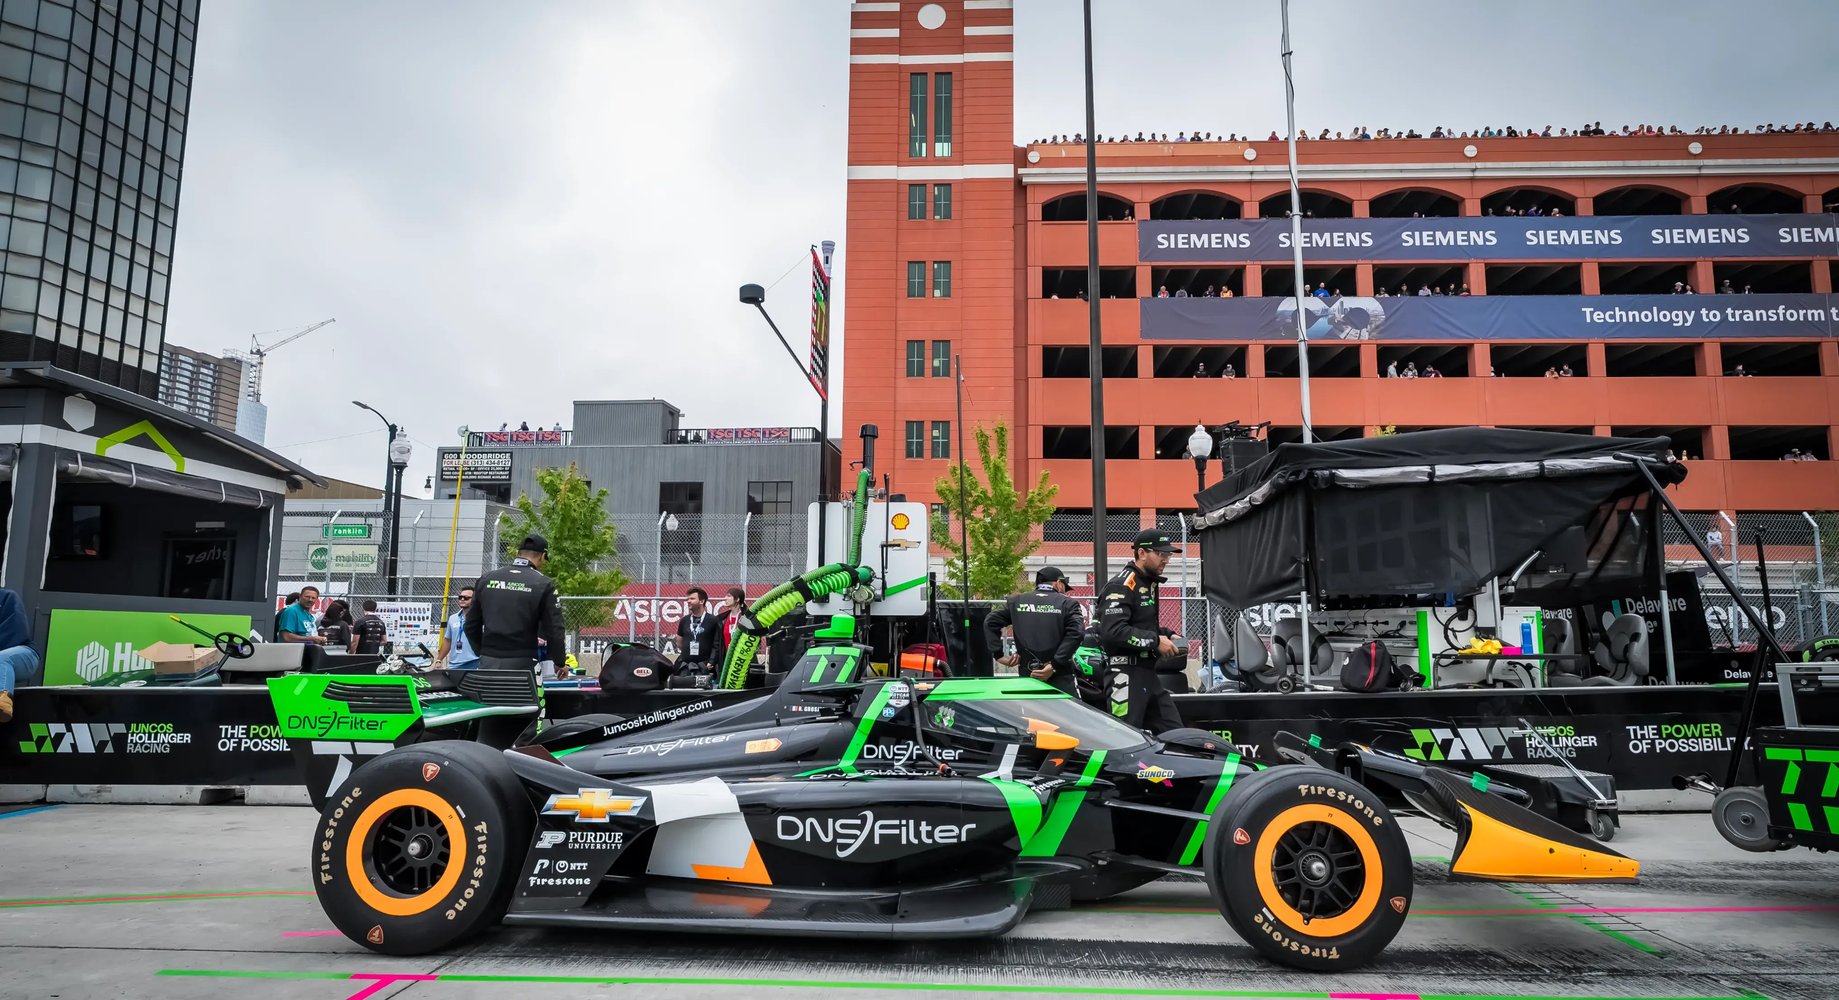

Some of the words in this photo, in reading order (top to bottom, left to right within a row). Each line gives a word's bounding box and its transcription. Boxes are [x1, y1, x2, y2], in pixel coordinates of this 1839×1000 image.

[1157, 233, 1250, 249] SIEMENS
[1401, 230, 1498, 247] SIEMENS
[1525, 229, 1623, 246] SIEMENS
[1651, 228, 1750, 244] SIEMENS
[1778, 227, 1839, 243] SIEM
[1582, 306, 1696, 326] Technology
[1700, 307, 1721, 322] to
[1725, 304, 1826, 322] transform
[485, 432, 508, 442] TSG
[512, 432, 534, 441] TSG
[538, 431, 560, 440] TSG
[709, 430, 734, 438] TSG
[737, 430, 761, 438] TSG
[764, 429, 789, 437] TSG
[335, 551, 375, 565] mobility
[603, 699, 713, 737] JuncosHollinger.com
[129, 723, 174, 734] JUNCOS
[219, 725, 247, 738] THE
[1626, 725, 1658, 739] THE
[1661, 723, 1723, 738] POWER
[128, 733, 192, 744] HOLLINGER
[218, 738, 239, 751] OF
[1525, 735, 1598, 748] HOLINGER
[127, 743, 170, 753] RACING
[1628, 740, 1652, 753] OF
[1138, 770, 1174, 778] SUNOCO
[1298, 784, 1383, 827] Firestone
[320, 786, 362, 885] Firestone
[569, 831, 623, 843] PURDUE
[445, 821, 488, 920] Firestone
[569, 862, 588, 870] NTT
[528, 876, 591, 887] Firestone
[1253, 913, 1341, 960] Firestone
